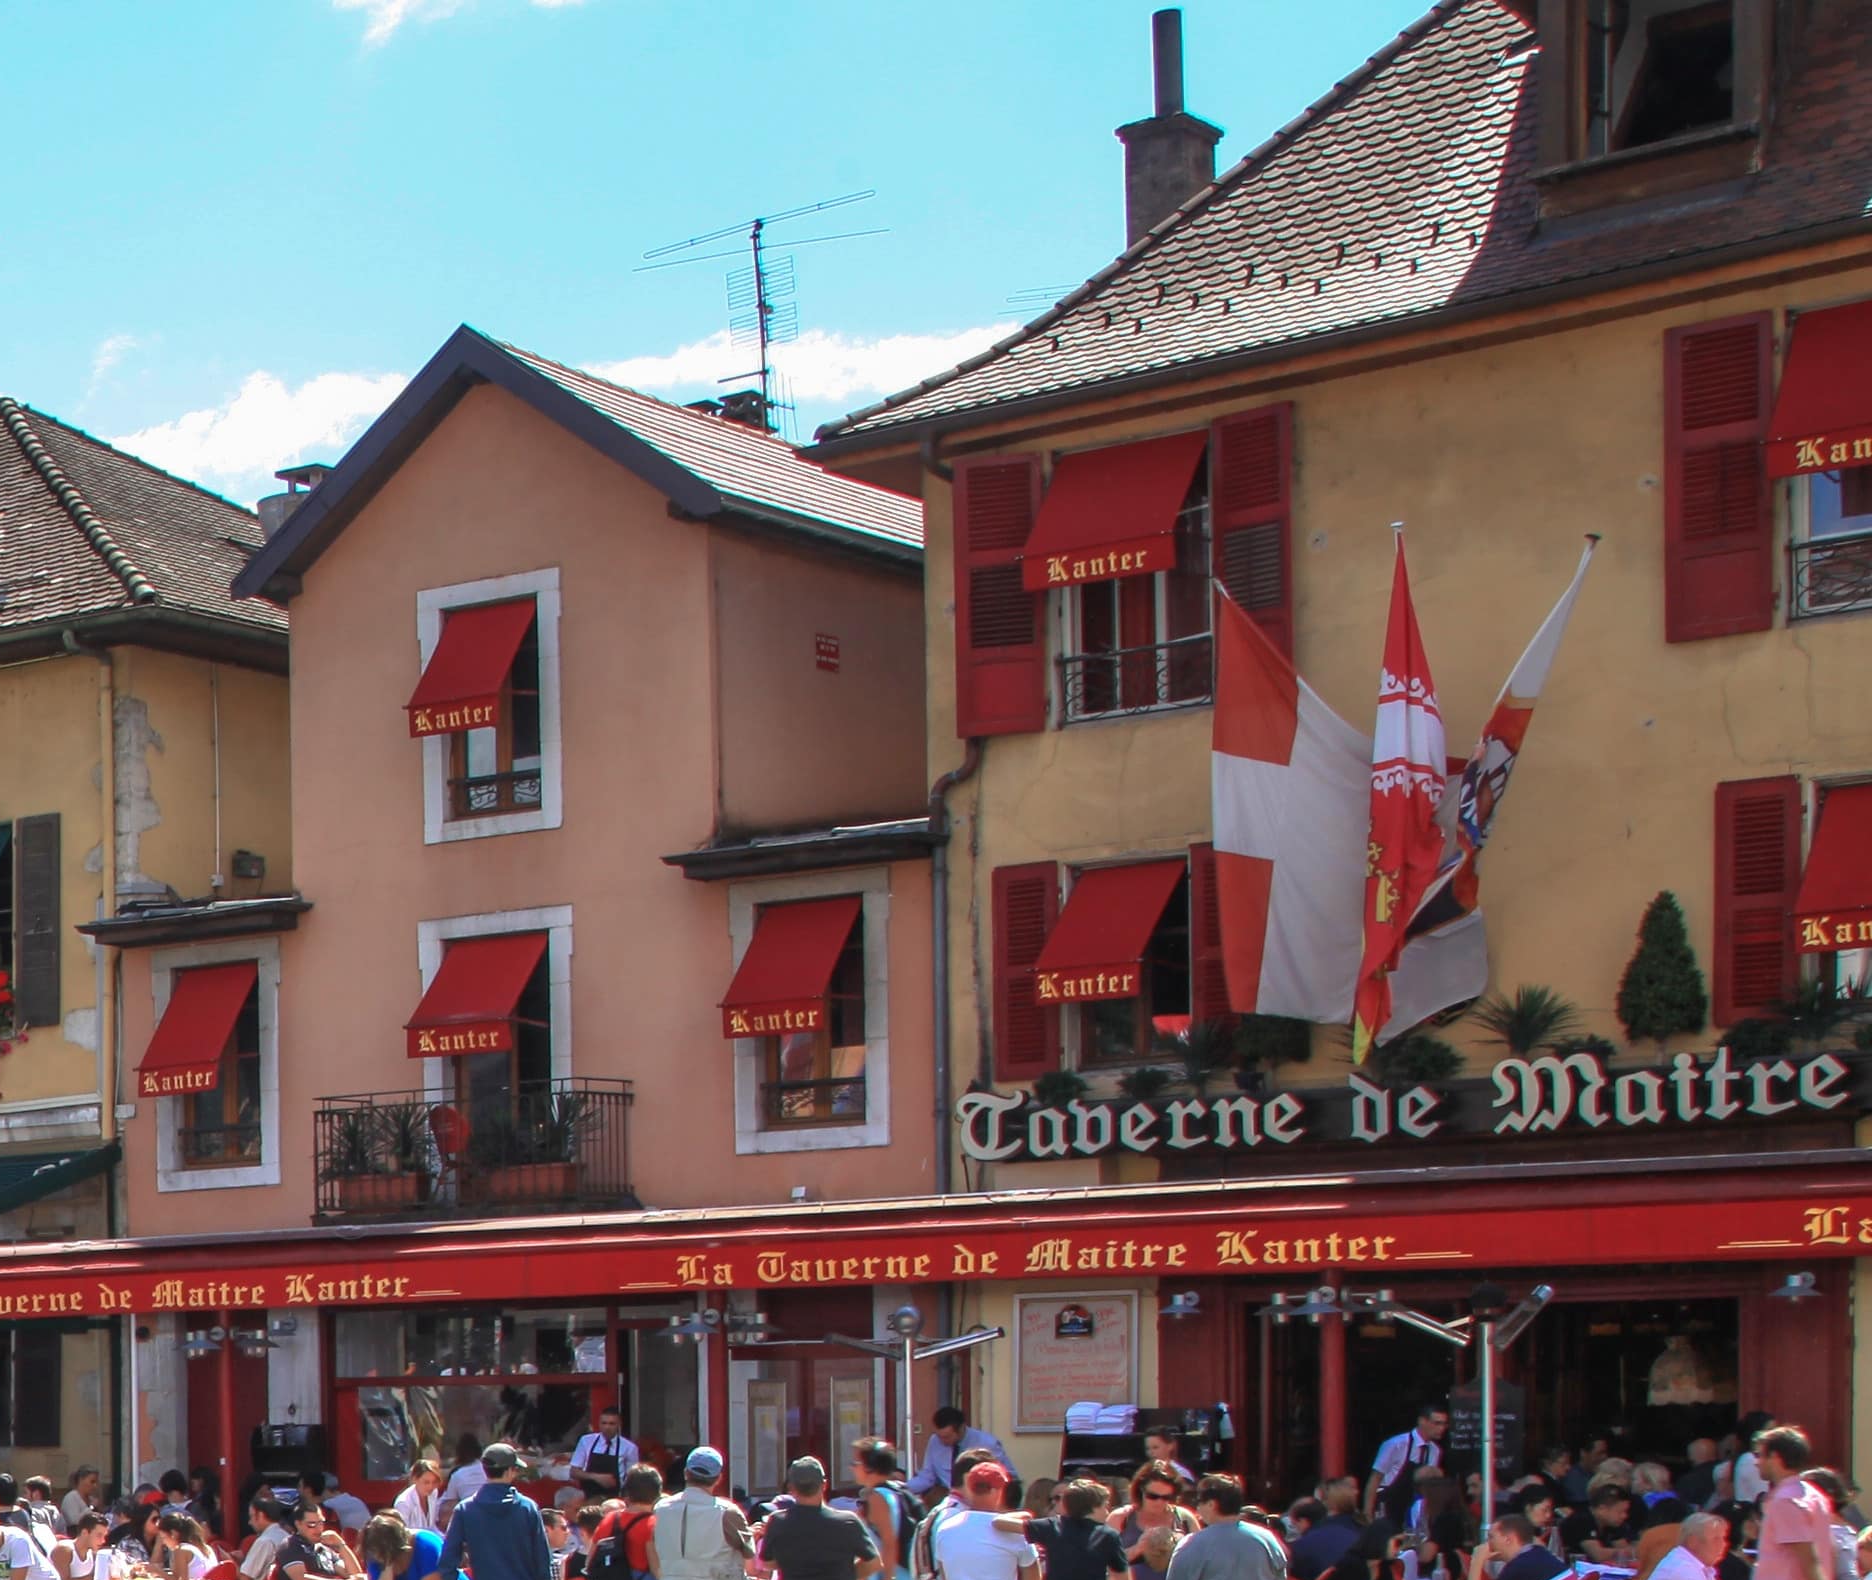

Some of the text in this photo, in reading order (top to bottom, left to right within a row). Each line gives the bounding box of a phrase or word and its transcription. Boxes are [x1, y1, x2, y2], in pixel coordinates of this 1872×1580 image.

[1046, 547, 1148, 586] Kanter
[414, 702, 495, 737] Kanter
[1036, 970, 1135, 1000] Kanter
[730, 1006, 820, 1035] Kanter
[417, 1026, 505, 1053] Kanter
[143, 1066, 216, 1094] Kanter
[955, 1046, 1852, 1162] Taverne de Maitre
[677, 1230, 1397, 1286] La Taverne de Maitre Kanter
[98, 1283, 133, 1309] de
[152, 1279, 265, 1308] Maitre
[285, 1274, 410, 1303] Kanter
